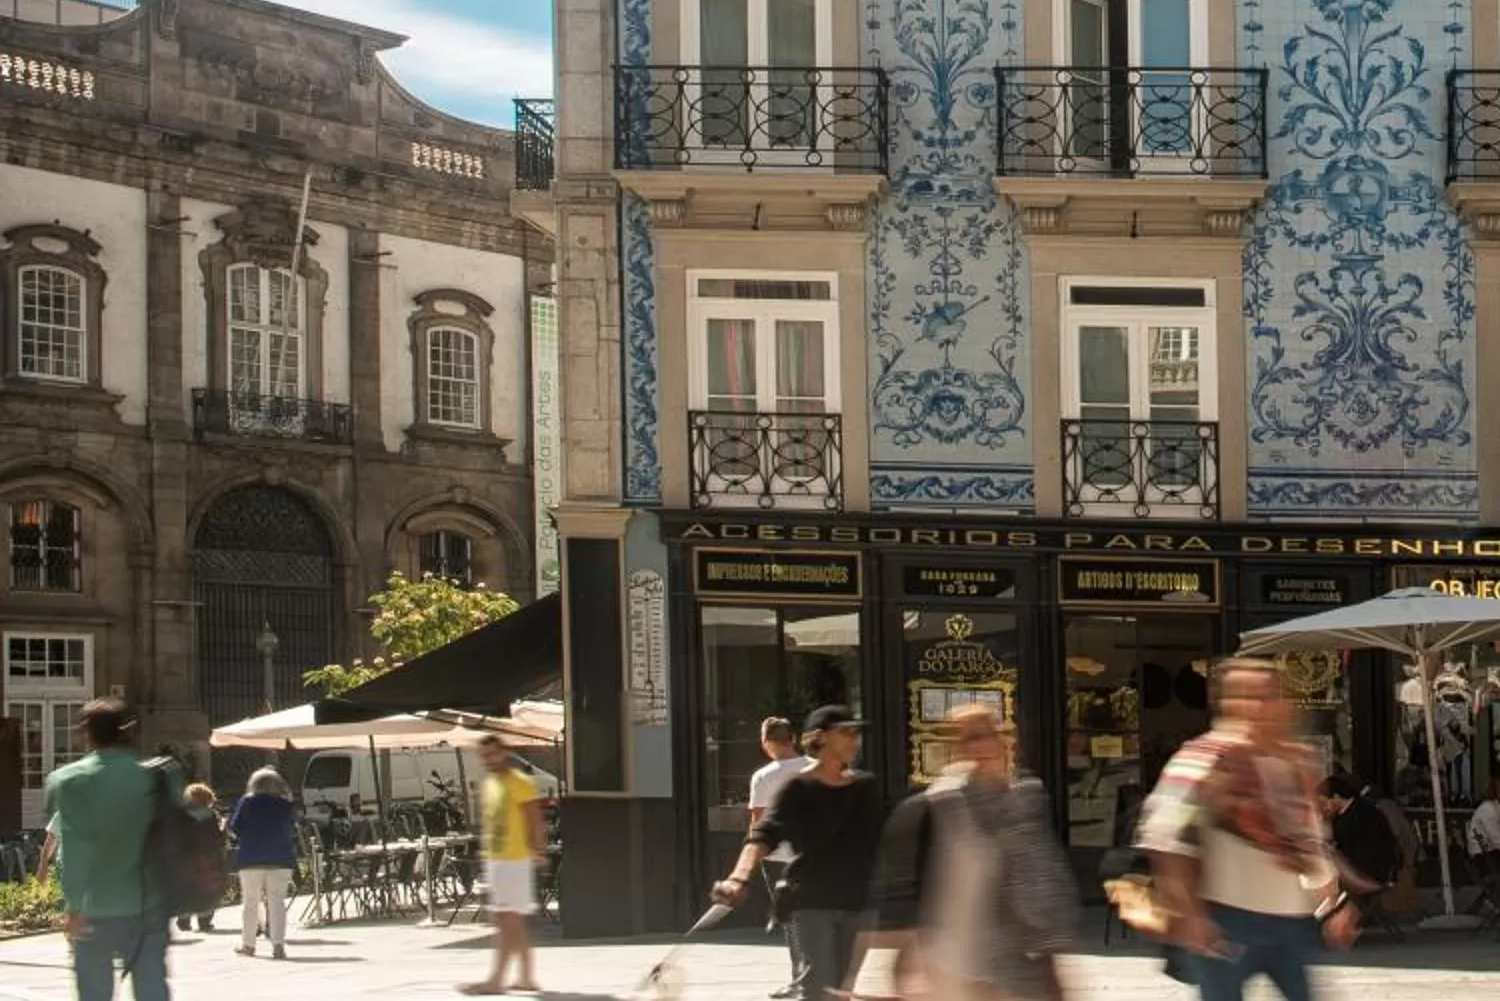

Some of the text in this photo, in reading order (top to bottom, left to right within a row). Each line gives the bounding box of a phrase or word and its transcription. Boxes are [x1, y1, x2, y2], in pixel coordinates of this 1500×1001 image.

[537, 370, 552, 430] Artes
[537, 435, 552, 472] das
[682, 523, 1037, 546] ACESSORIOS
[1064, 533, 1212, 551] PARA
[1077, 570, 1123, 589] ARTIGOS
[924, 647, 994, 660] GALERIA
[919, 659, 944, 672] DO
